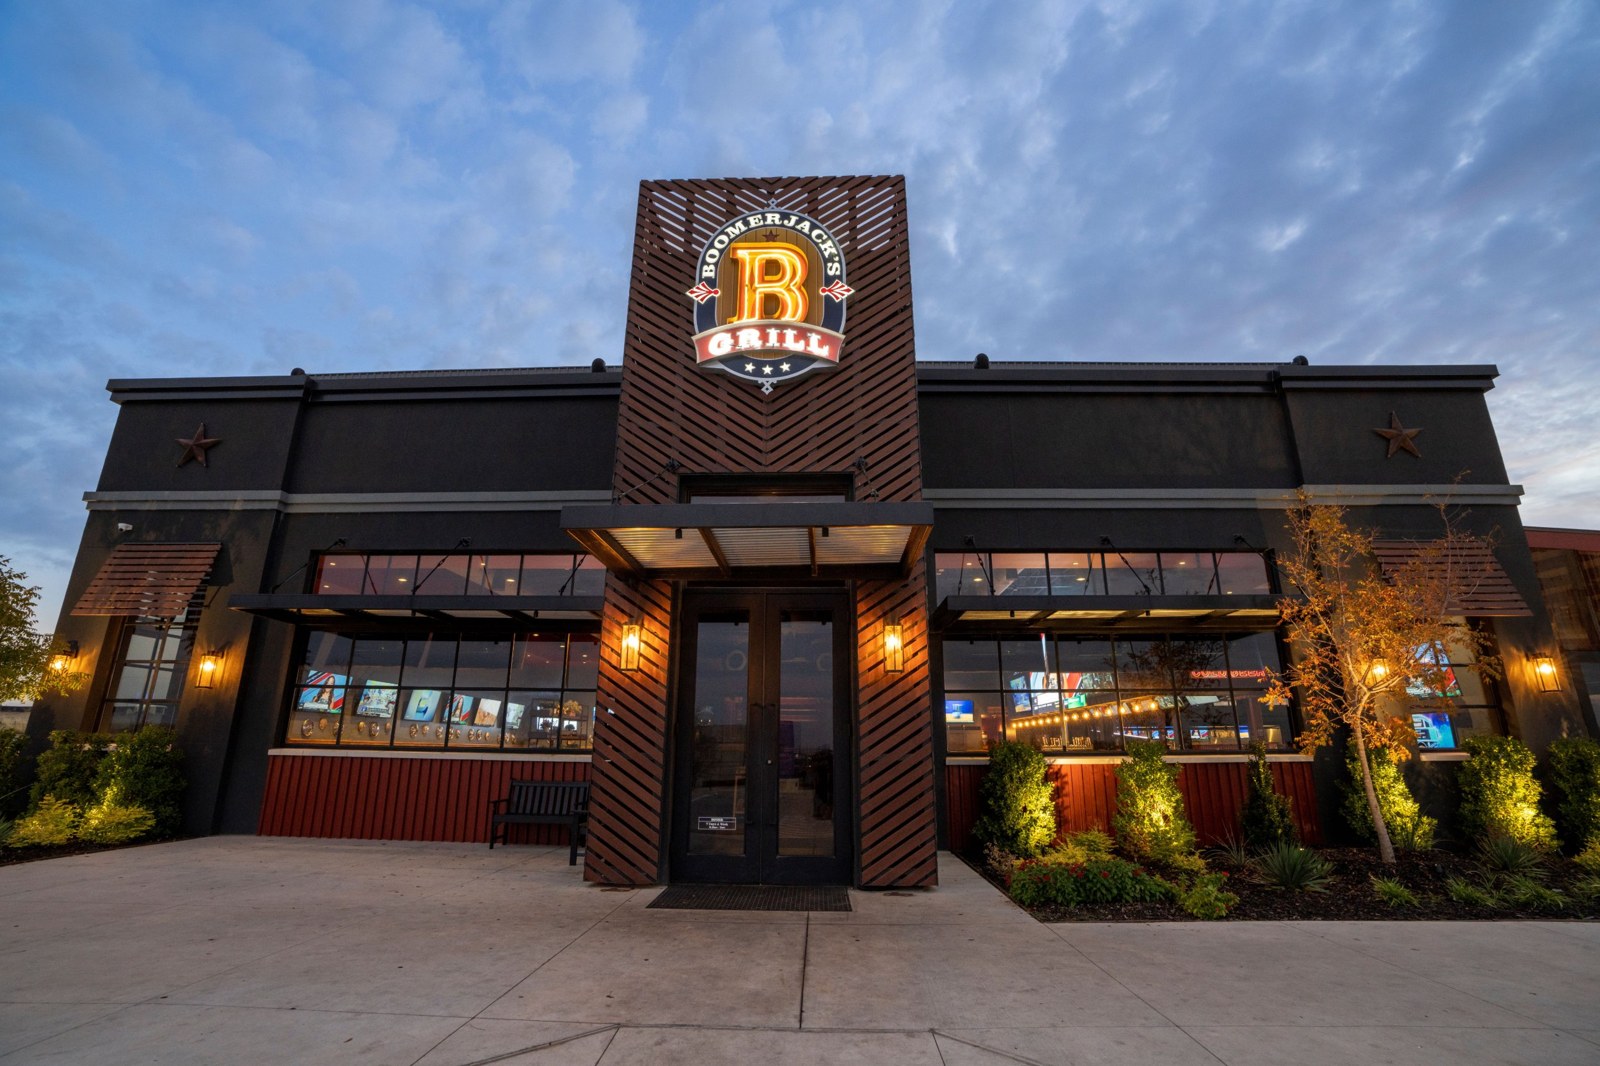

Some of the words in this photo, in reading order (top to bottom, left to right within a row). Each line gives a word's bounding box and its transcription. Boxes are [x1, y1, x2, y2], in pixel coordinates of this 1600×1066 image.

[702, 213, 841, 278] BOOMERJACK'S
[727, 242, 809, 324] B
[708, 328, 829, 356] GRILL
